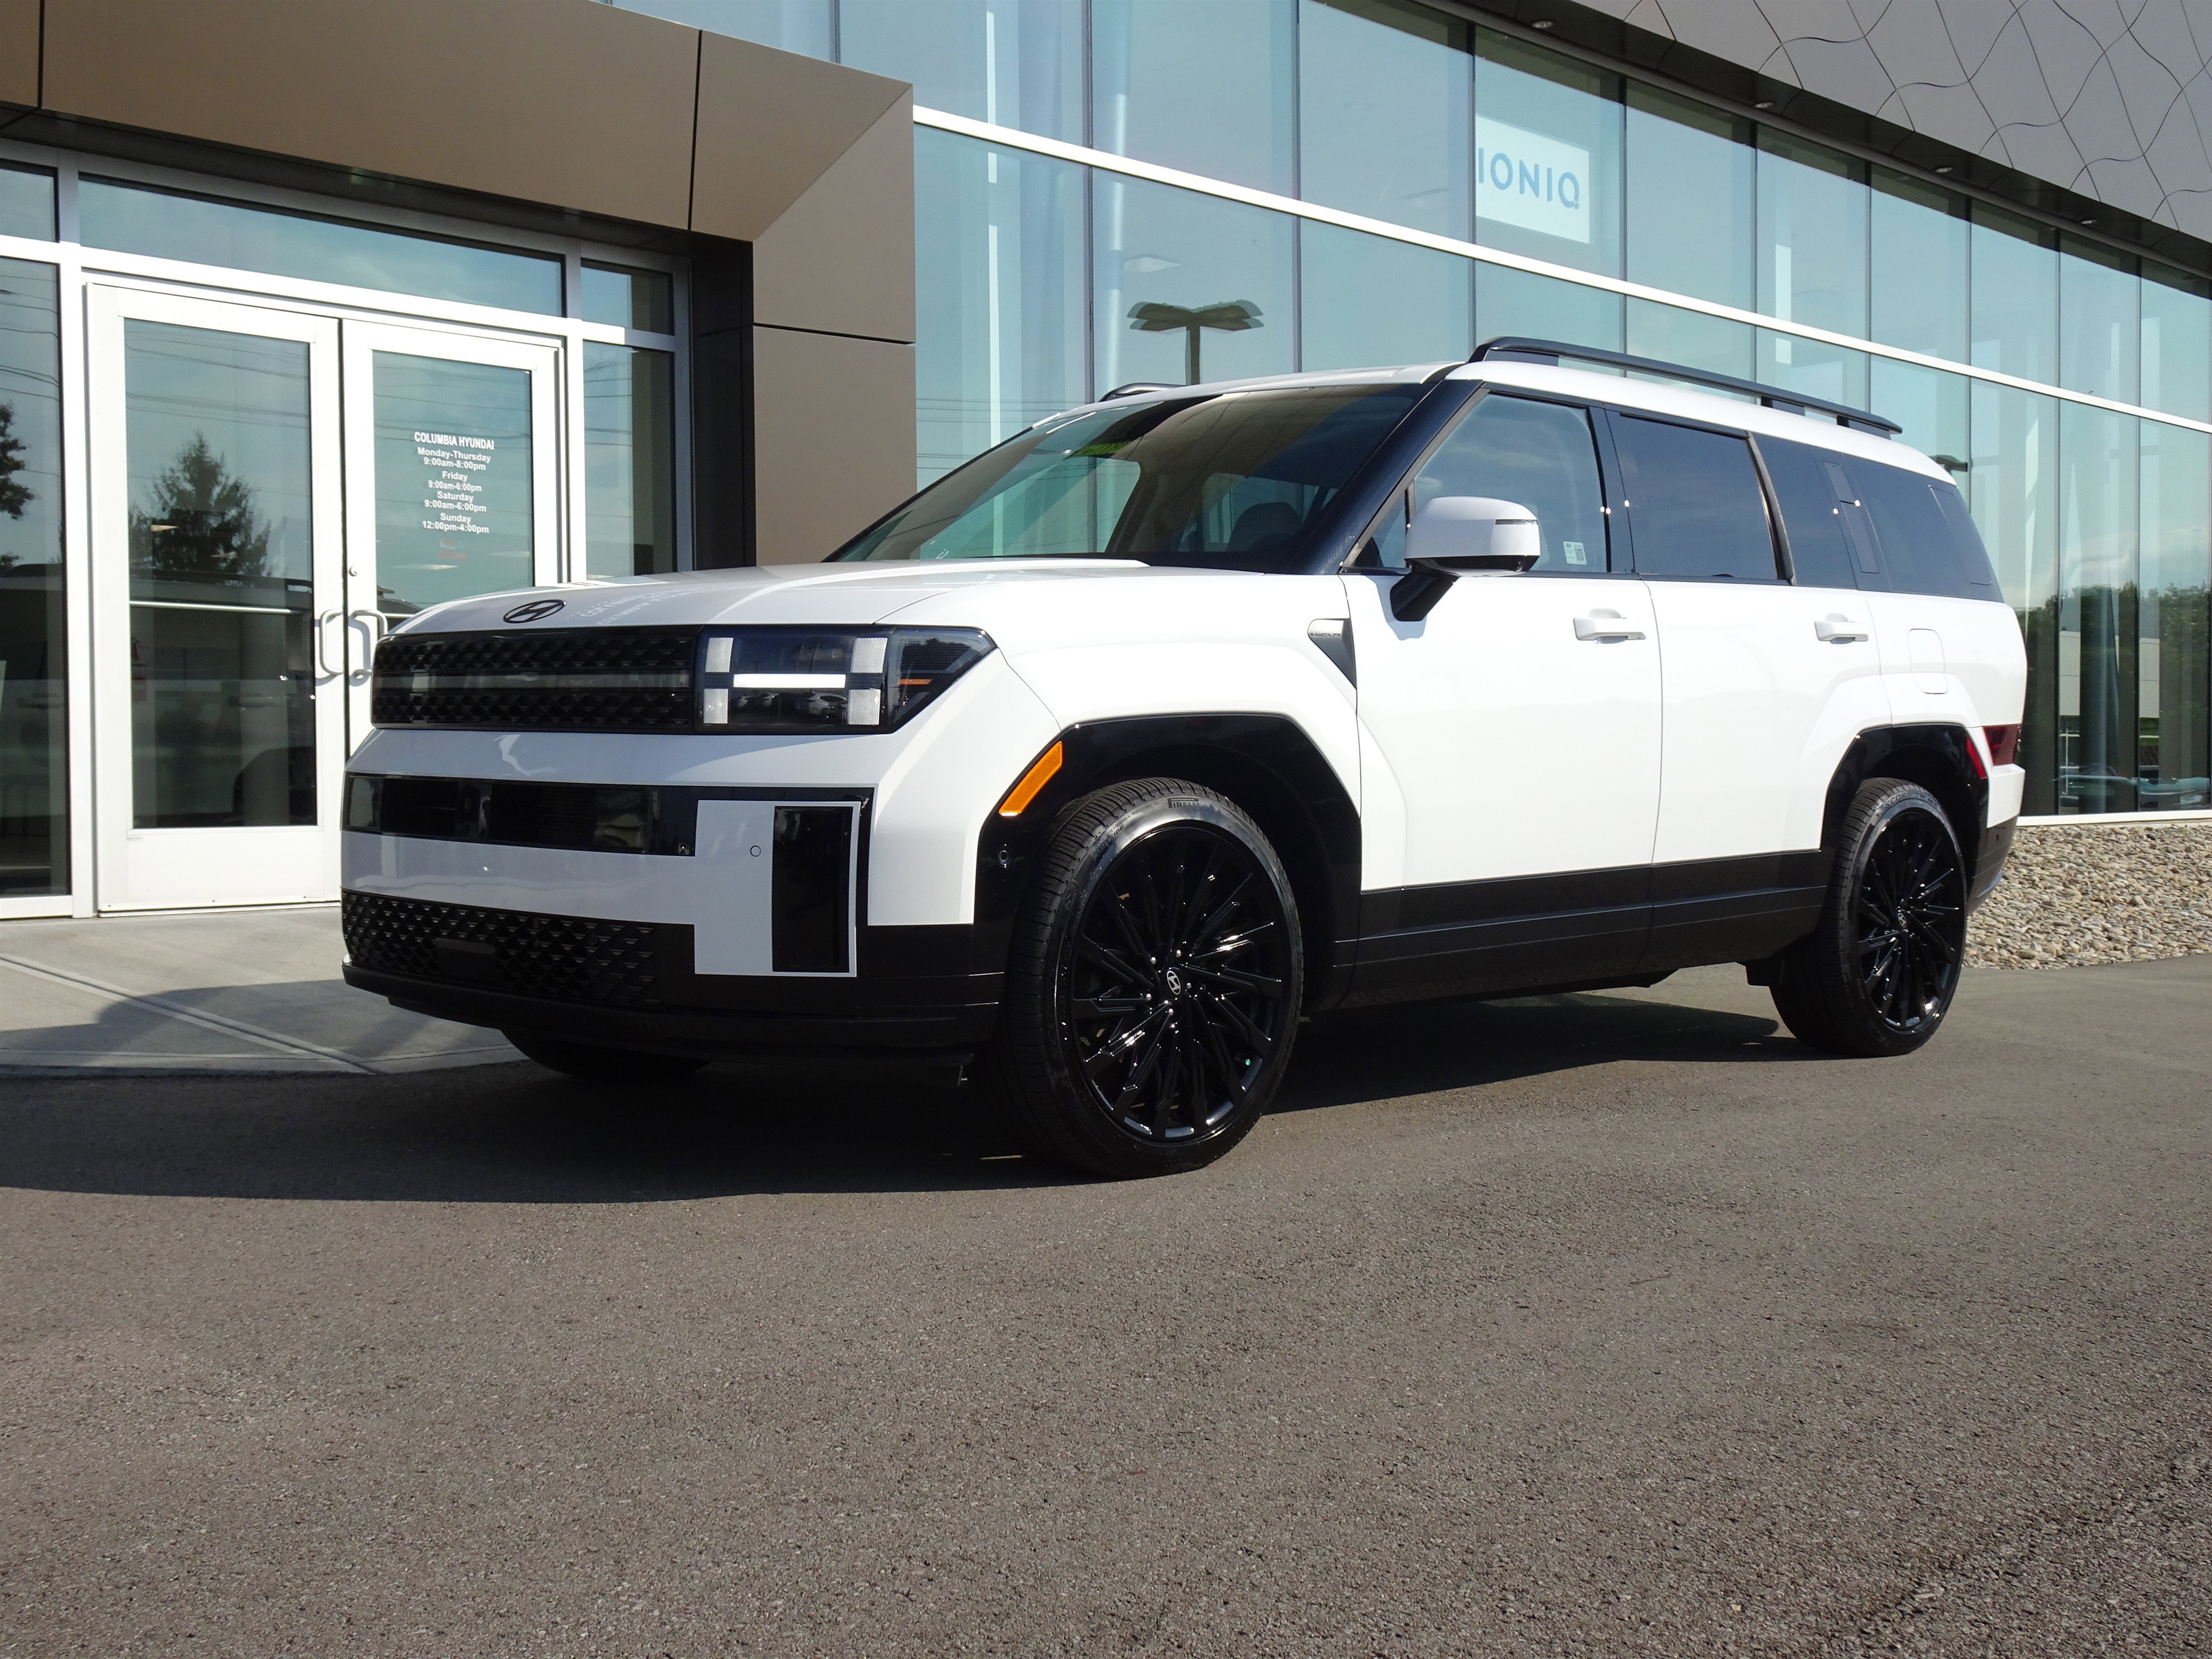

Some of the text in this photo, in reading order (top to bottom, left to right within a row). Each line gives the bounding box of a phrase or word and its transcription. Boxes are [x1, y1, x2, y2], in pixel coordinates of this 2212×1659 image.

[1479, 147, 1580, 210] IONIQ
[414, 431, 495, 450] COLUMBIA HYUNDAI
[417, 447, 491, 463] Monday-Thursday
[423, 456, 487, 471] 9:00am-8:00pm
[442, 470, 468, 482] Friday
[428, 480, 482, 493] 9:00am-6:00pm
[437, 490, 474, 503] Saturday
[424, 499, 487, 513] 9:00am-6:00pm
[440, 512, 471, 524] Sunday
[422, 521, 489, 534] 12:00pm-4:00pm
[1168, 798, 1200, 809] PIRELLI
